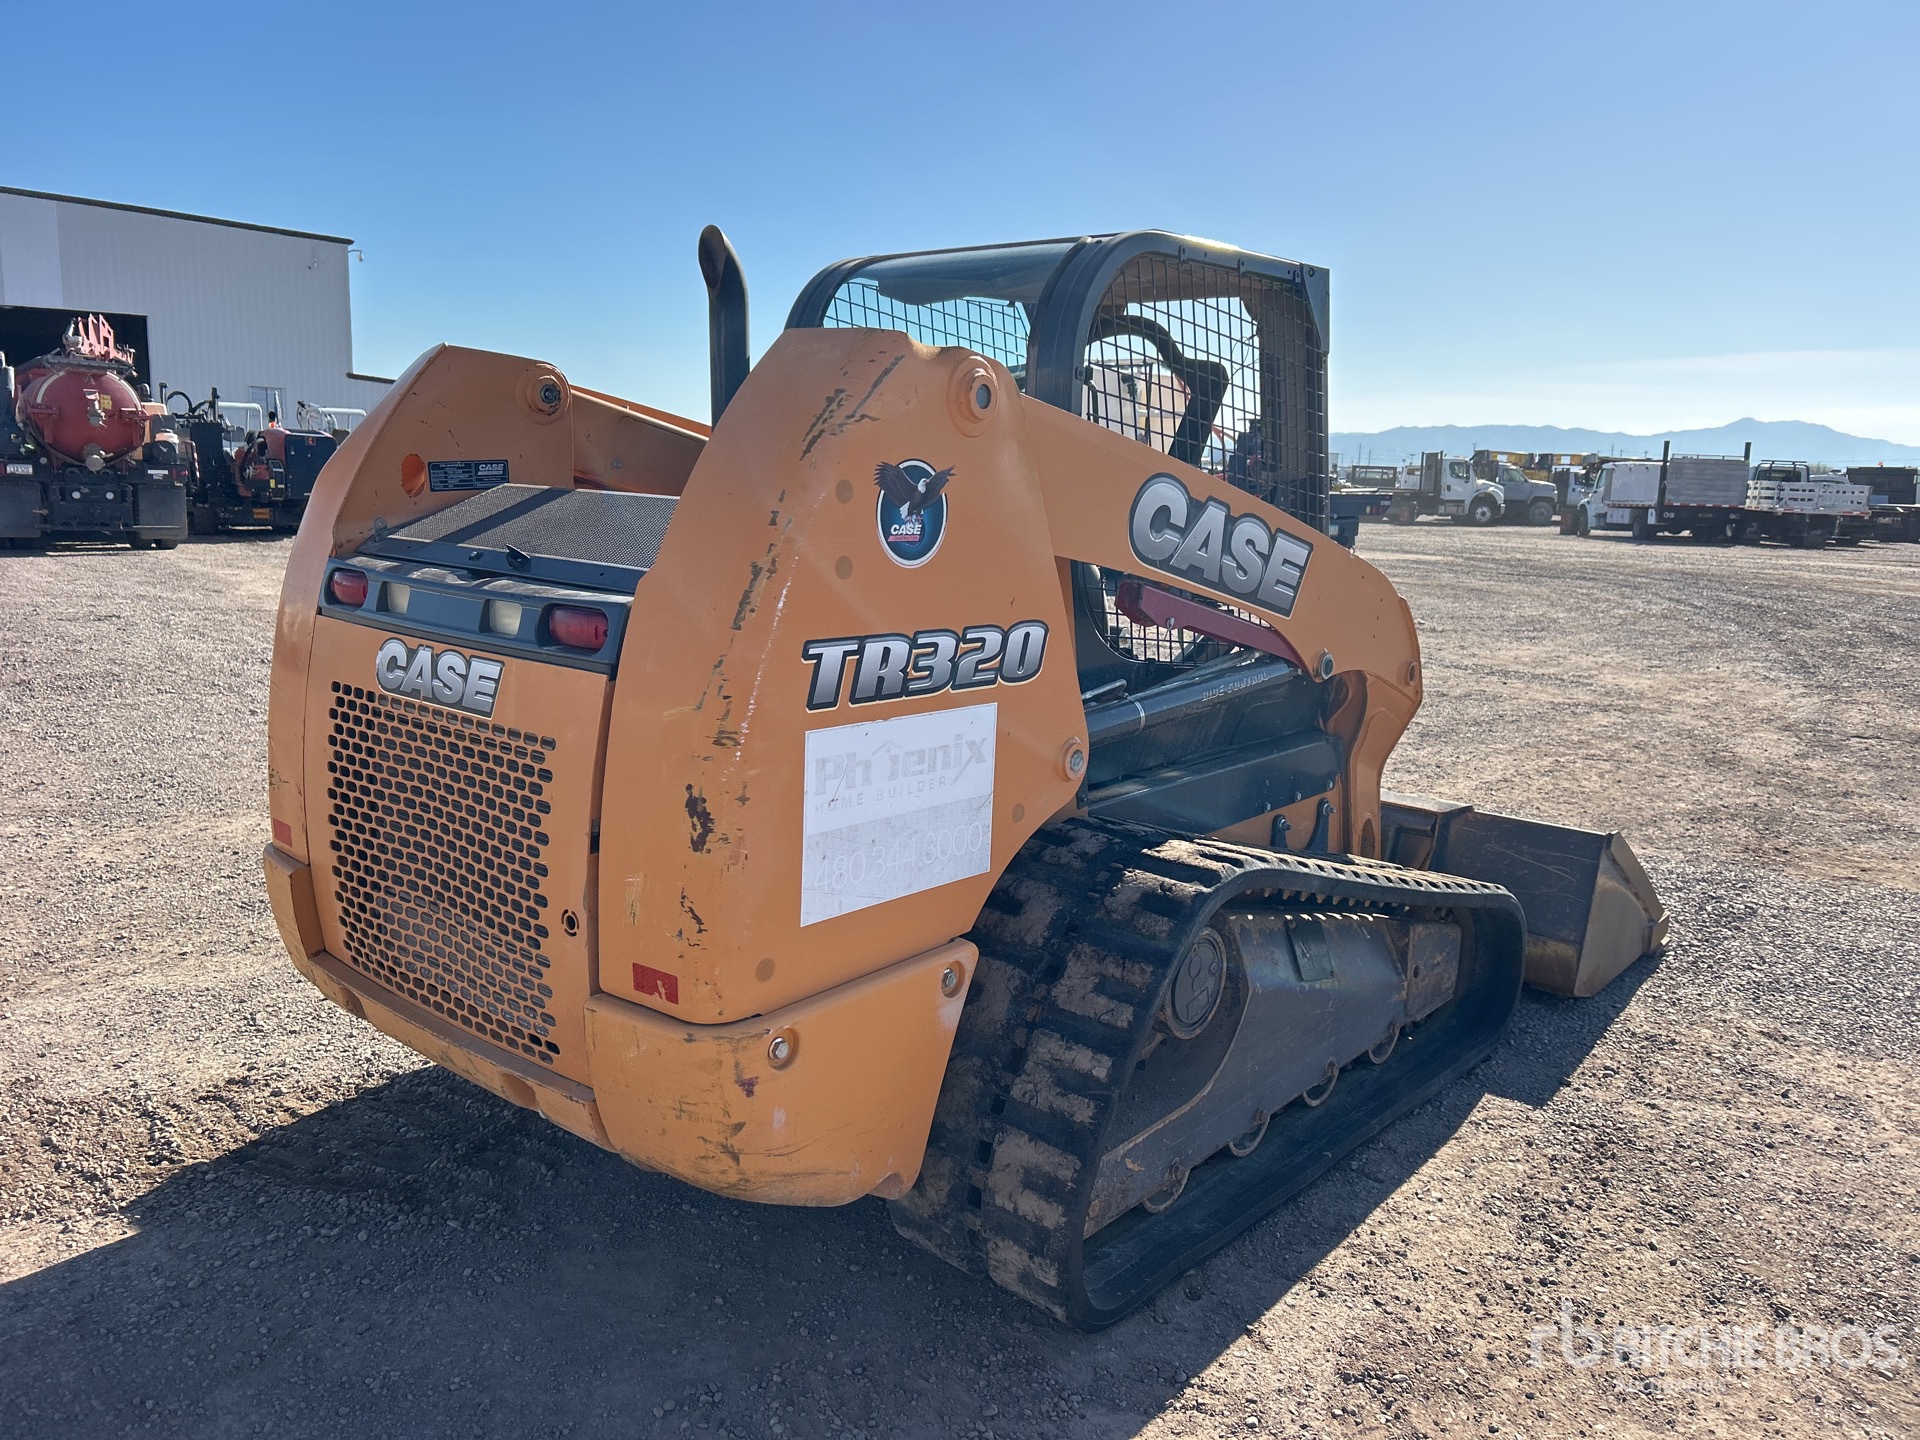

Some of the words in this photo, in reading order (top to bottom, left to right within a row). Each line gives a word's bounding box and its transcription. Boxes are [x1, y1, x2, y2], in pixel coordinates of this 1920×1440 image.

[890, 524, 922, 535] CASE
[1131, 475, 1311, 615] CASE
[376, 638, 504, 717] CASE
[803, 622, 1048, 711] TR320
[815, 793, 864, 814] HOME
[813, 822, 983, 891] 480.344.3000
